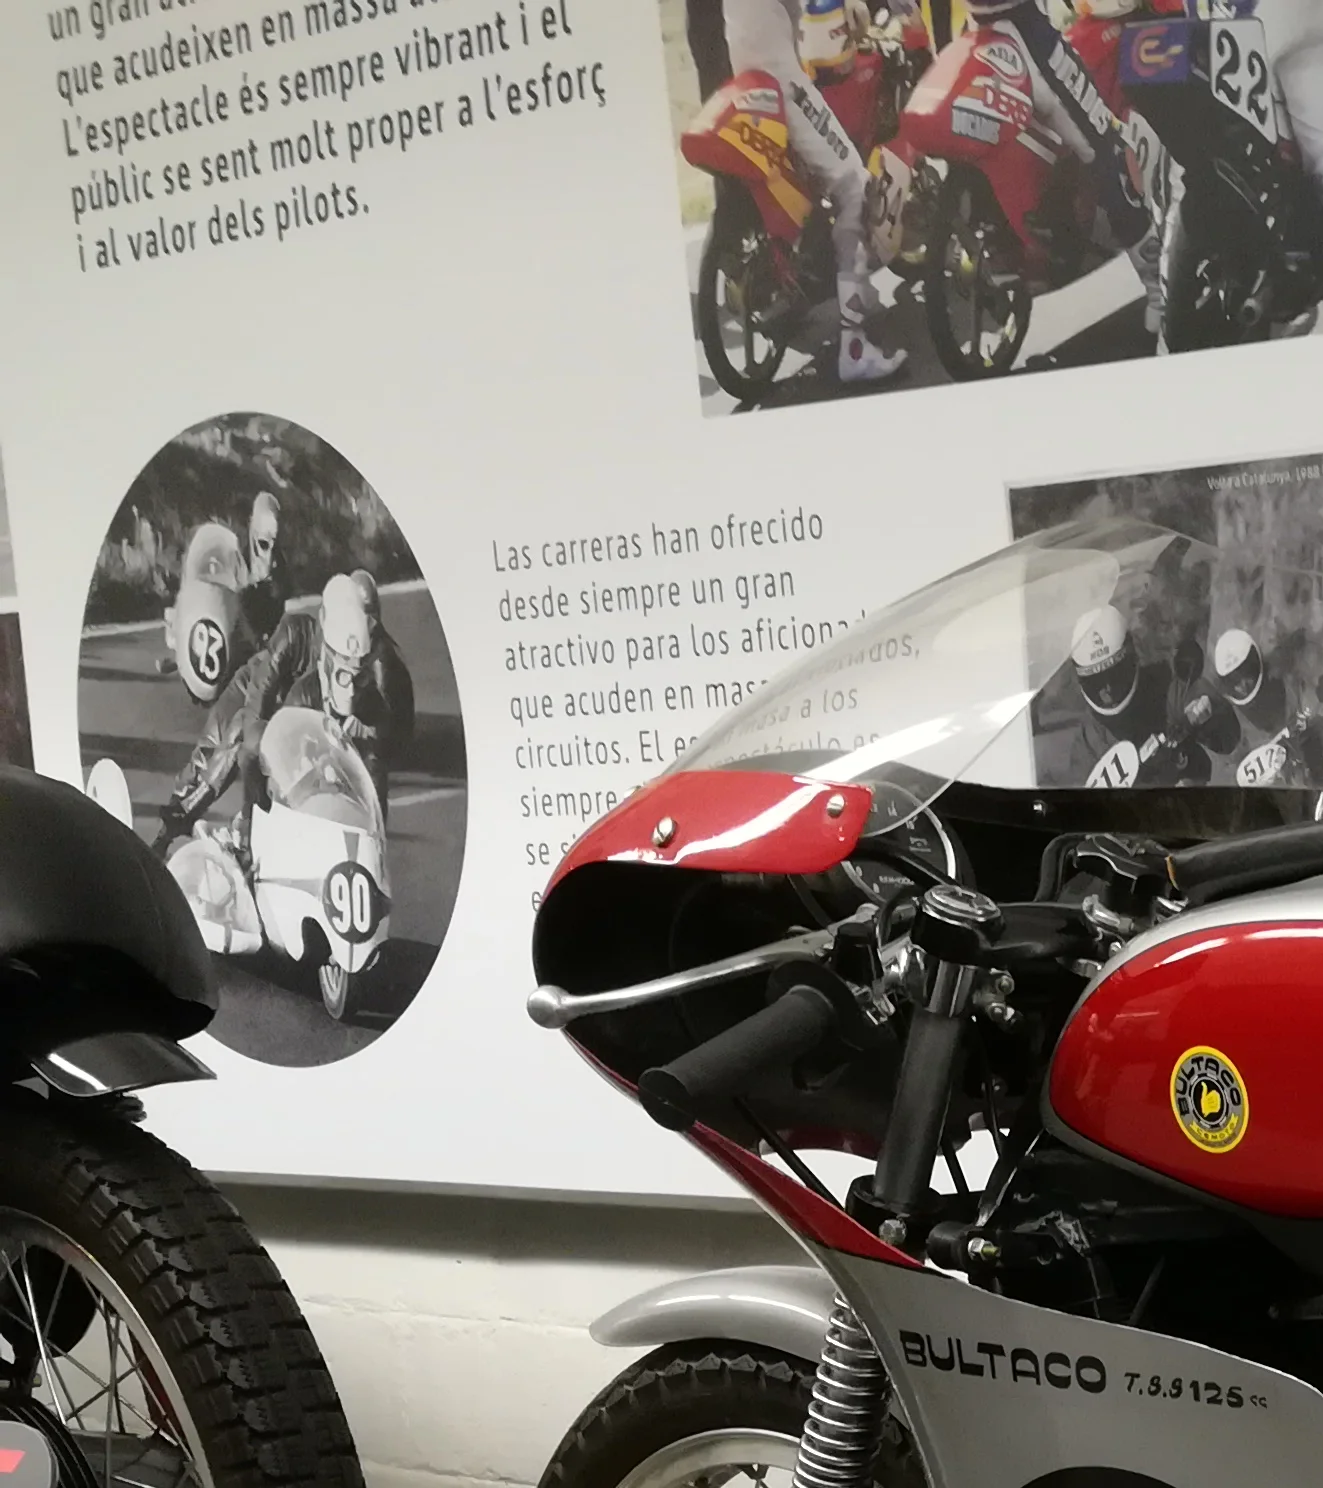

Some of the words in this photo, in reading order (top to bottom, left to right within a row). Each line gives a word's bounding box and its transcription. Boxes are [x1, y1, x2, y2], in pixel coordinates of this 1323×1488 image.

[48, 6, 81, 41] un
[57, 61, 104, 107] que
[113, 22, 252, 85] acudeixen
[261, 10, 295, 47] en
[63, 84, 229, 157] L'espectacle
[239, 72, 269, 115] és
[279, 51, 384, 106] sempre
[394, 12, 510, 76] vibrant
[519, 0, 529, 45] i
[541, 0, 572, 40] el
[1215, 28, 1268, 127] 22
[71, 162, 154, 225] públic
[163, 162, 191, 195] se
[201, 139, 261, 186] sent
[270, 120, 338, 171] molt
[347, 101, 444, 163] proper
[458, 95, 473, 127] a
[483, 62, 606, 121] l'esforç
[77, 234, 86, 272] i
[96, 227, 120, 268] al
[127, 216, 196, 261] valor
[208, 199, 264, 246] dels
[274, 182, 369, 242] pilots.
[493, 540, 531, 572] Las
[542, 533, 642, 567] carreras
[652, 522, 699, 556] han
[711, 506, 822, 550] ofrecido
[500, 586, 569, 621] desde
[580, 582, 680, 617] siempre
[692, 578, 723, 604] un
[736, 572, 794, 609] gran
[191, 620, 225, 681] 93
[506, 634, 614, 671] atractivo
[626, 629, 681, 669] para
[691, 624, 729, 656] los
[511, 695, 553, 727] que
[565, 682, 653, 716] acuden
[665, 685, 693, 710] en
[516, 735, 629, 769] circuitos.
[639, 730, 664, 762] El
[521, 786, 617, 823] siempre
[526, 843, 549, 865] se
[329, 872, 370, 934] 90
[1175, 1055, 1242, 1116] BULTACO
[898, 1328, 1107, 1394] BULTACO
[1188, 1379, 1245, 1409] 125
